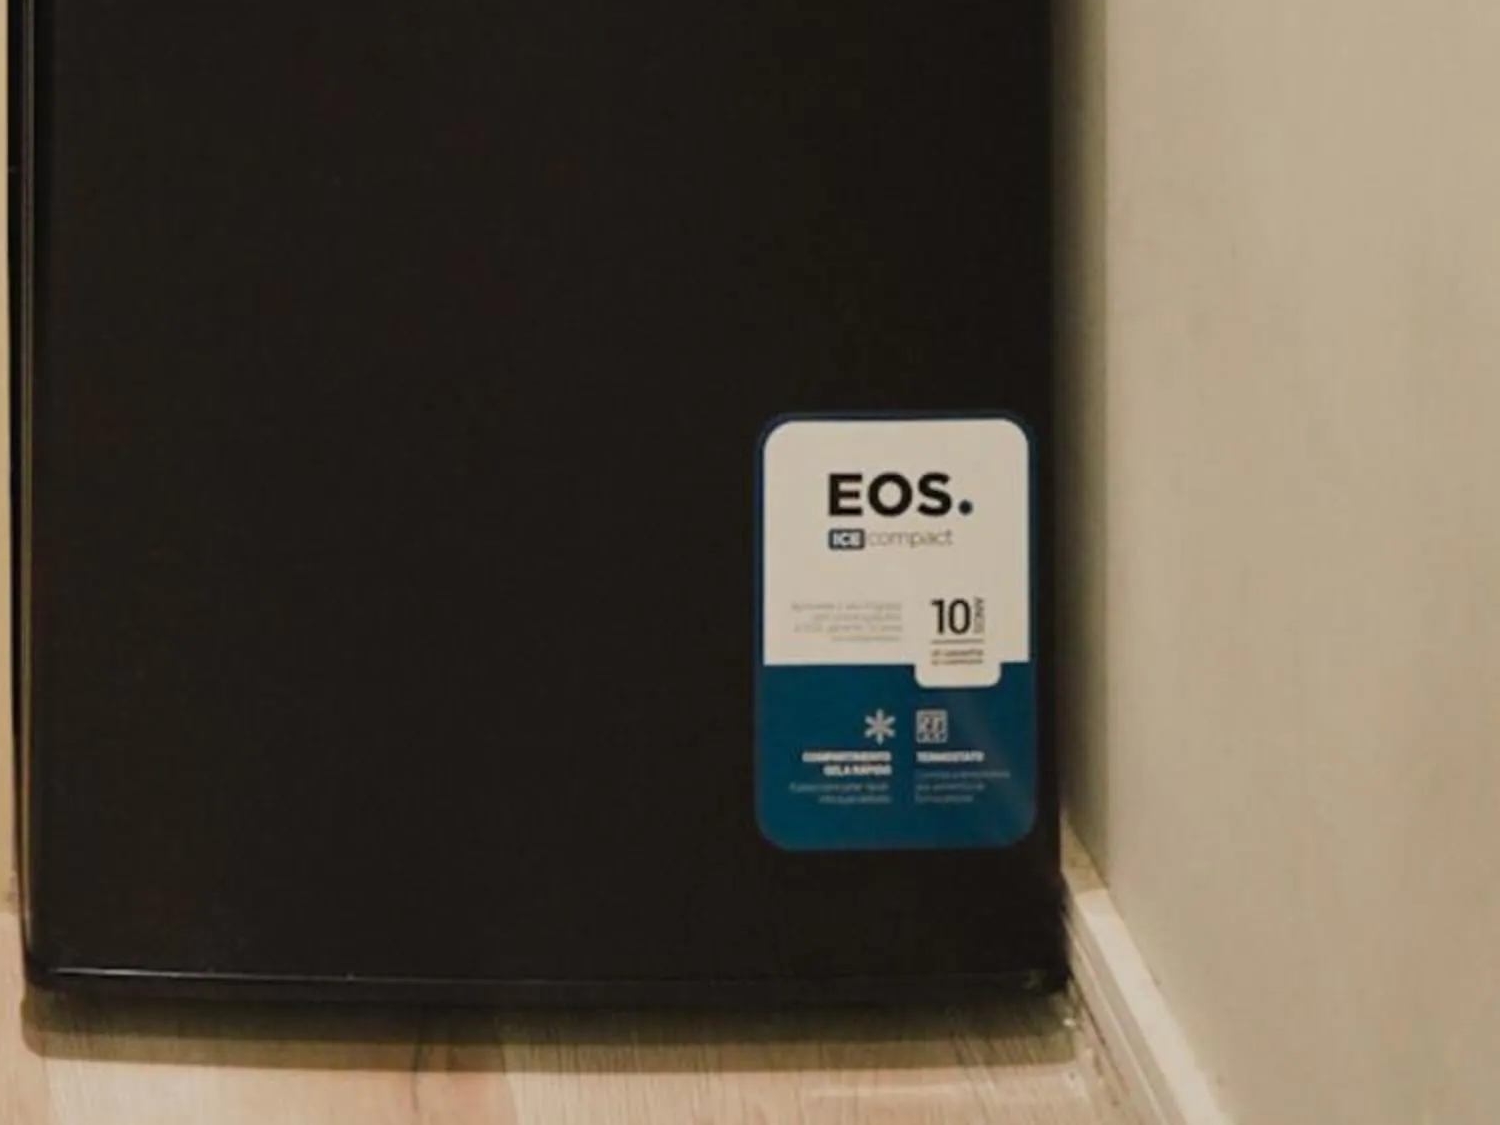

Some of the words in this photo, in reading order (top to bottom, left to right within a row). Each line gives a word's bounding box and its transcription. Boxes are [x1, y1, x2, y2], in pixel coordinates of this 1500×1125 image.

[828, 472, 973, 517] EOS.
[832, 531, 862, 548] ICE
[868, 529, 954, 549] compact
[929, 598, 972, 635] 10
